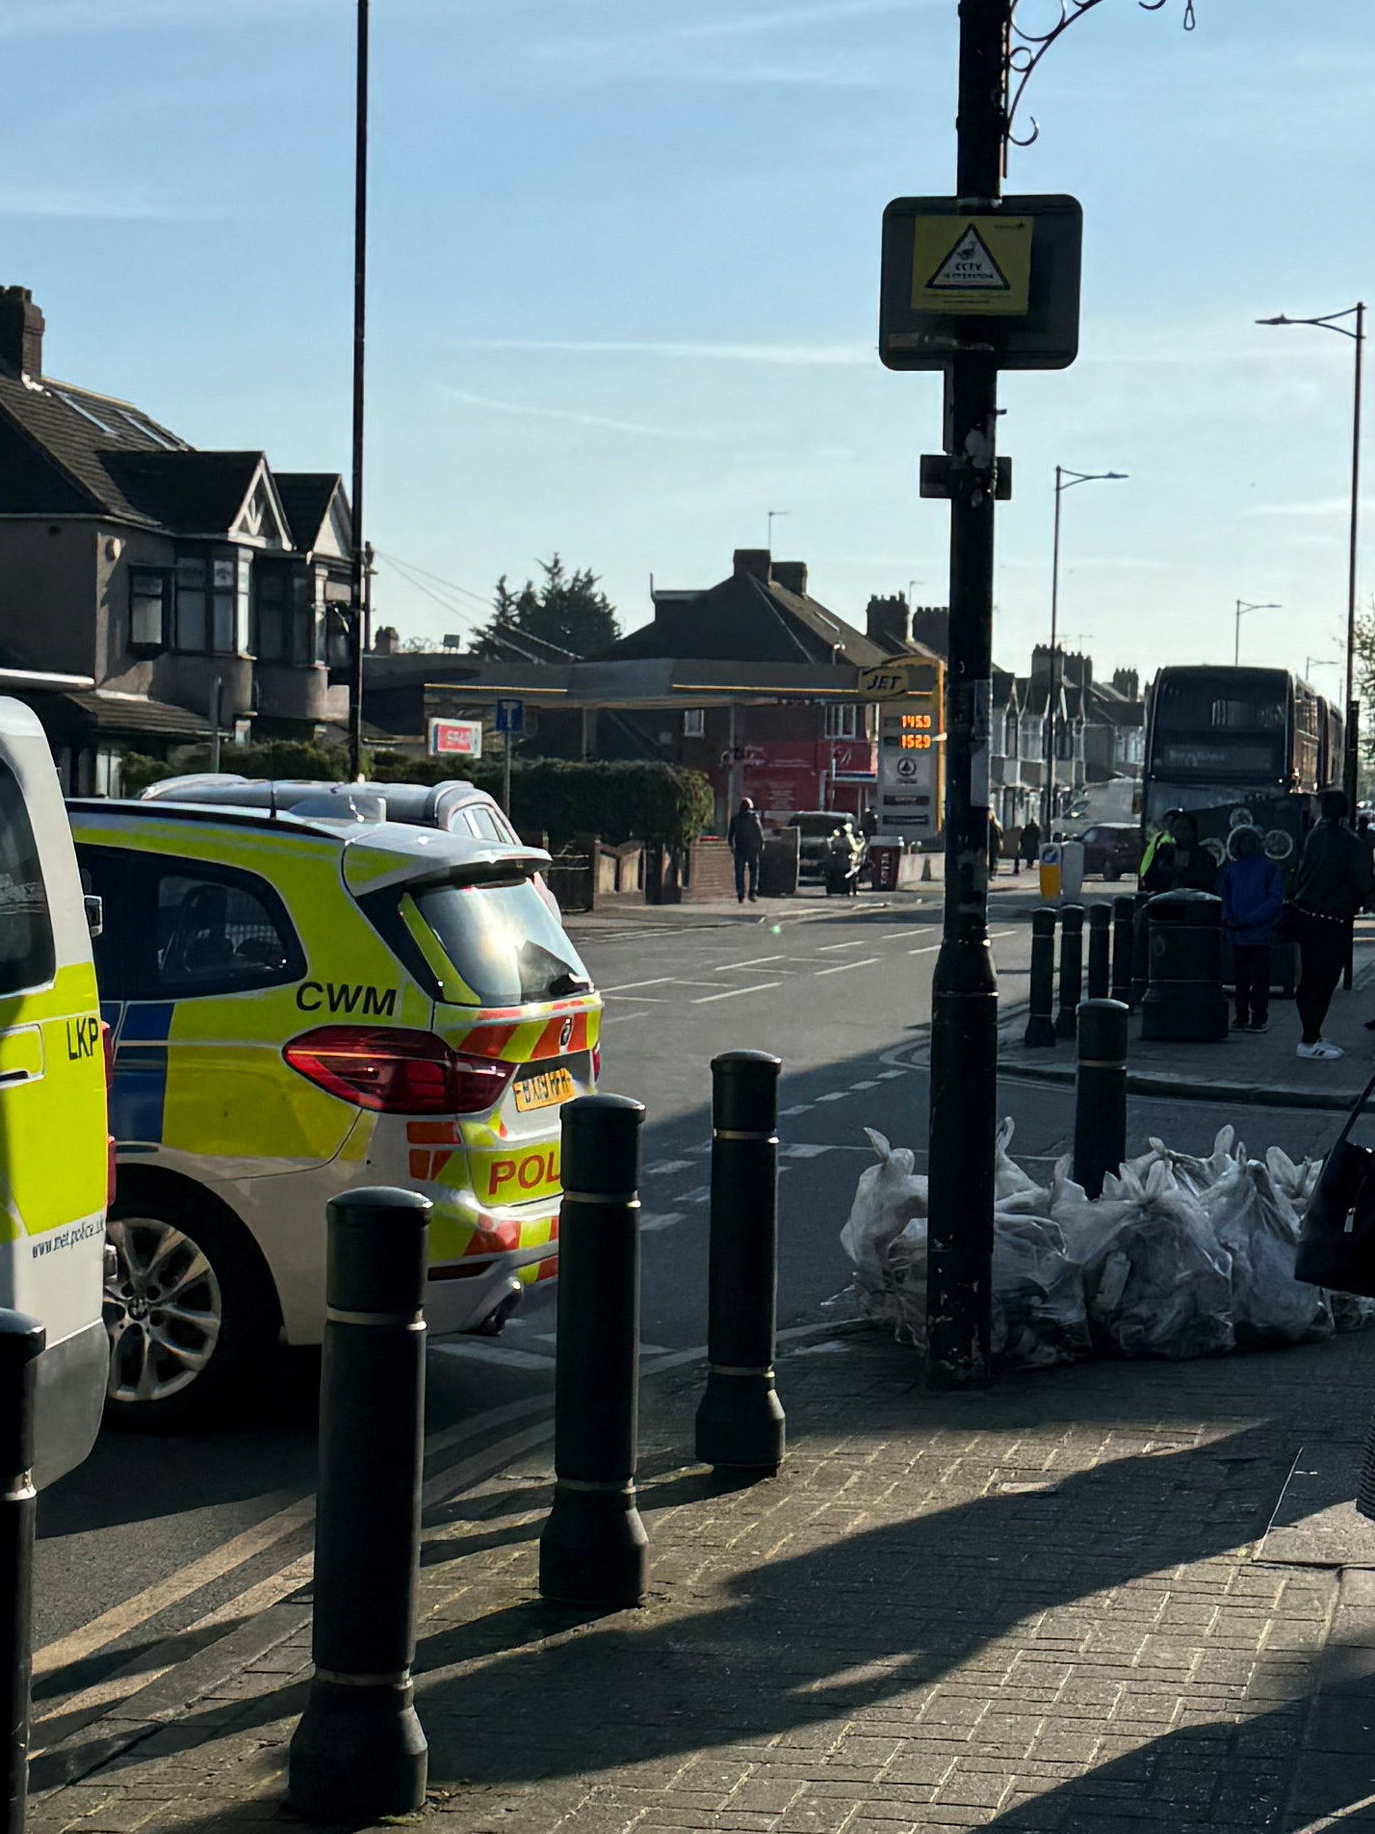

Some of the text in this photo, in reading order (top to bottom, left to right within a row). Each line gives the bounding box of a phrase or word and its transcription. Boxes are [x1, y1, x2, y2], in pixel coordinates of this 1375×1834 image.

[867, 675, 902, 690] JET
[295, 981, 397, 1016] CWM
[66, 1017, 99, 1060] LKP
